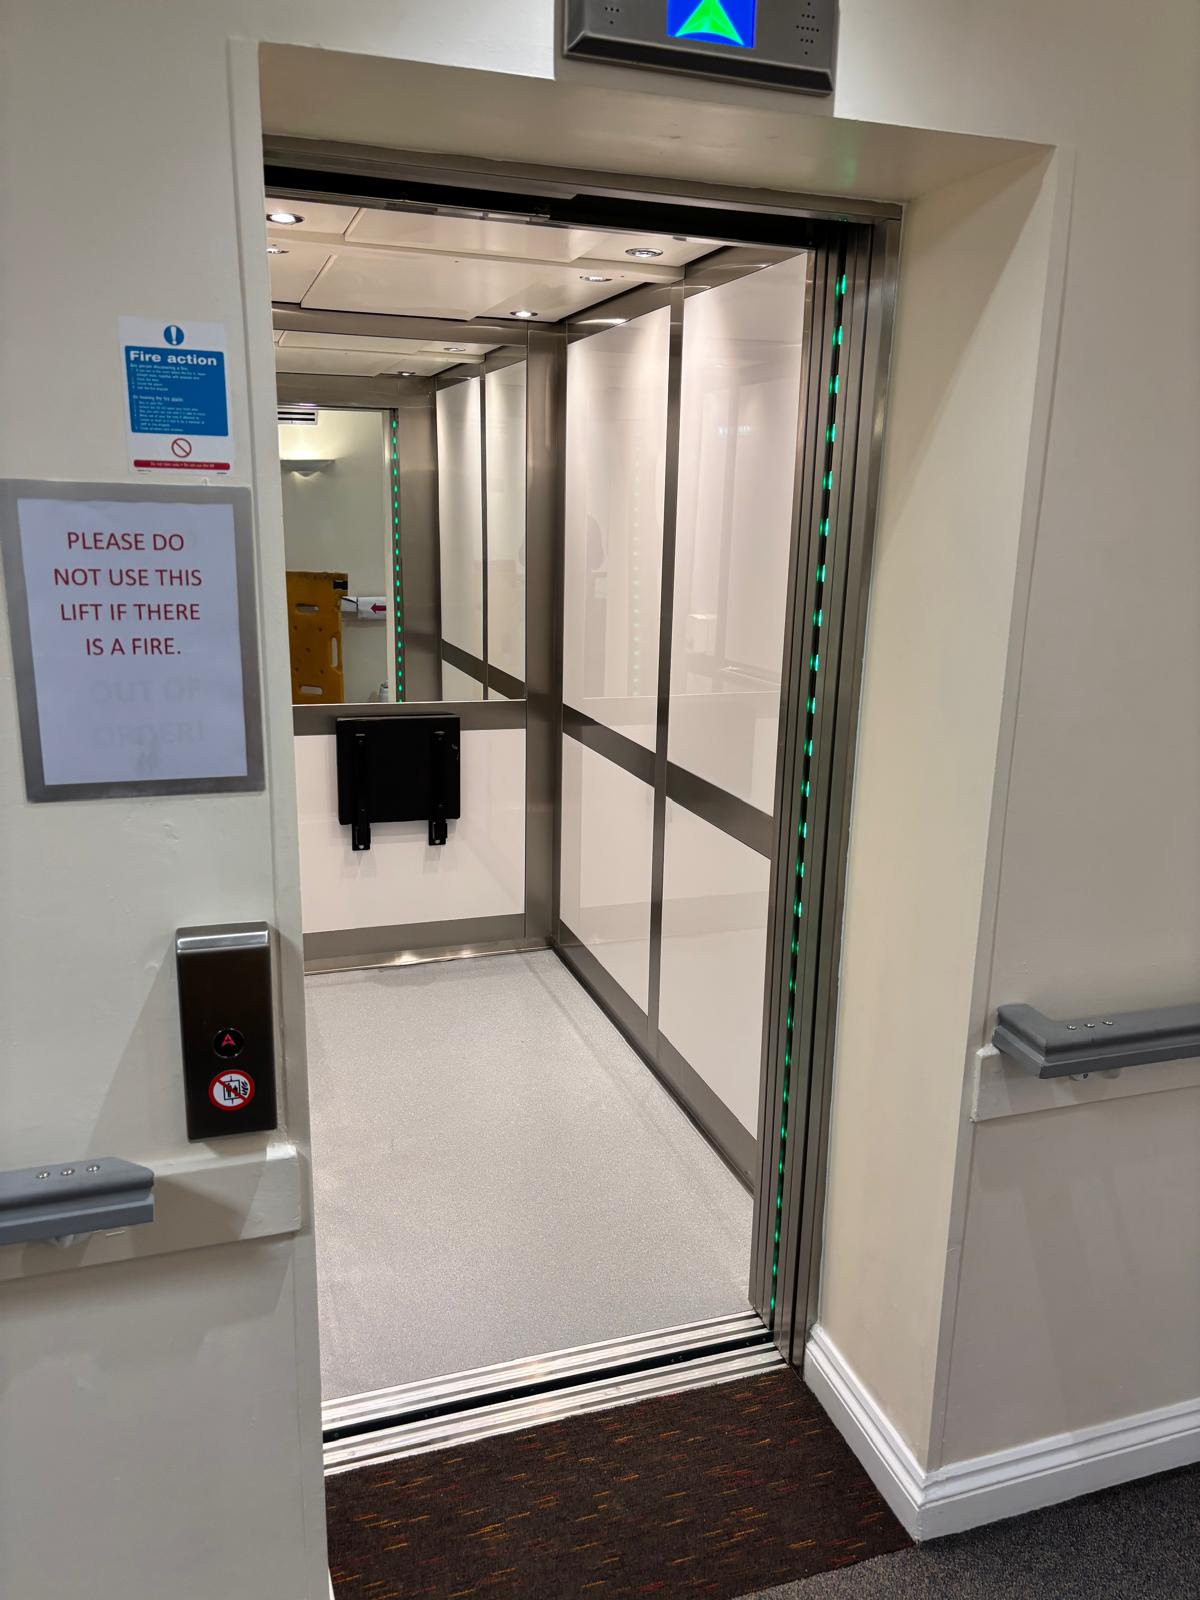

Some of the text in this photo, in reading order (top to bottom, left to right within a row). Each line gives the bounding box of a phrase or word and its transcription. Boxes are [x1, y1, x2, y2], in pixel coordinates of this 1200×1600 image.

[130, 350, 217, 366] Fire action
[67, 532, 184, 551] PLEASE DO
[53, 568, 203, 586] NOT USE THIS
[60, 603, 201, 621] LIFT IF THERE
[86, 637, 181, 656] IS A FIRE.
